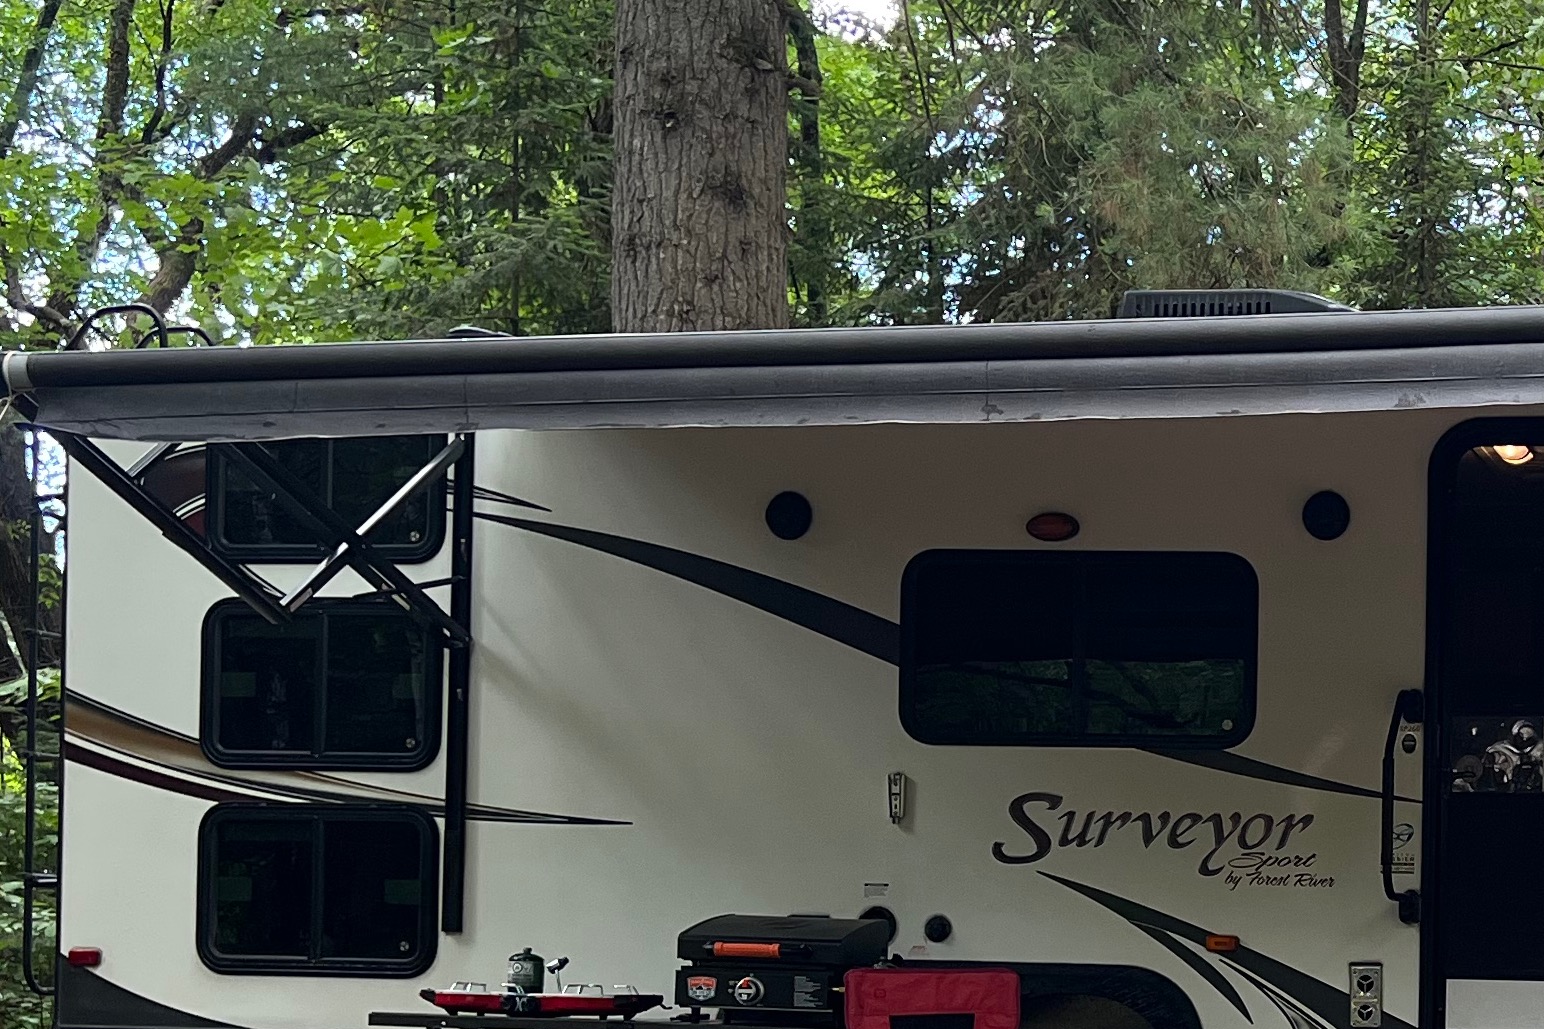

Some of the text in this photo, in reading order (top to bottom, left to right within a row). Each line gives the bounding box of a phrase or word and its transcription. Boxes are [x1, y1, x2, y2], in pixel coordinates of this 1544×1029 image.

[992, 791, 1315, 876] Surveyor
[1227, 851, 1317, 872] Sport
[1224, 870, 1336, 891] by Forest River
